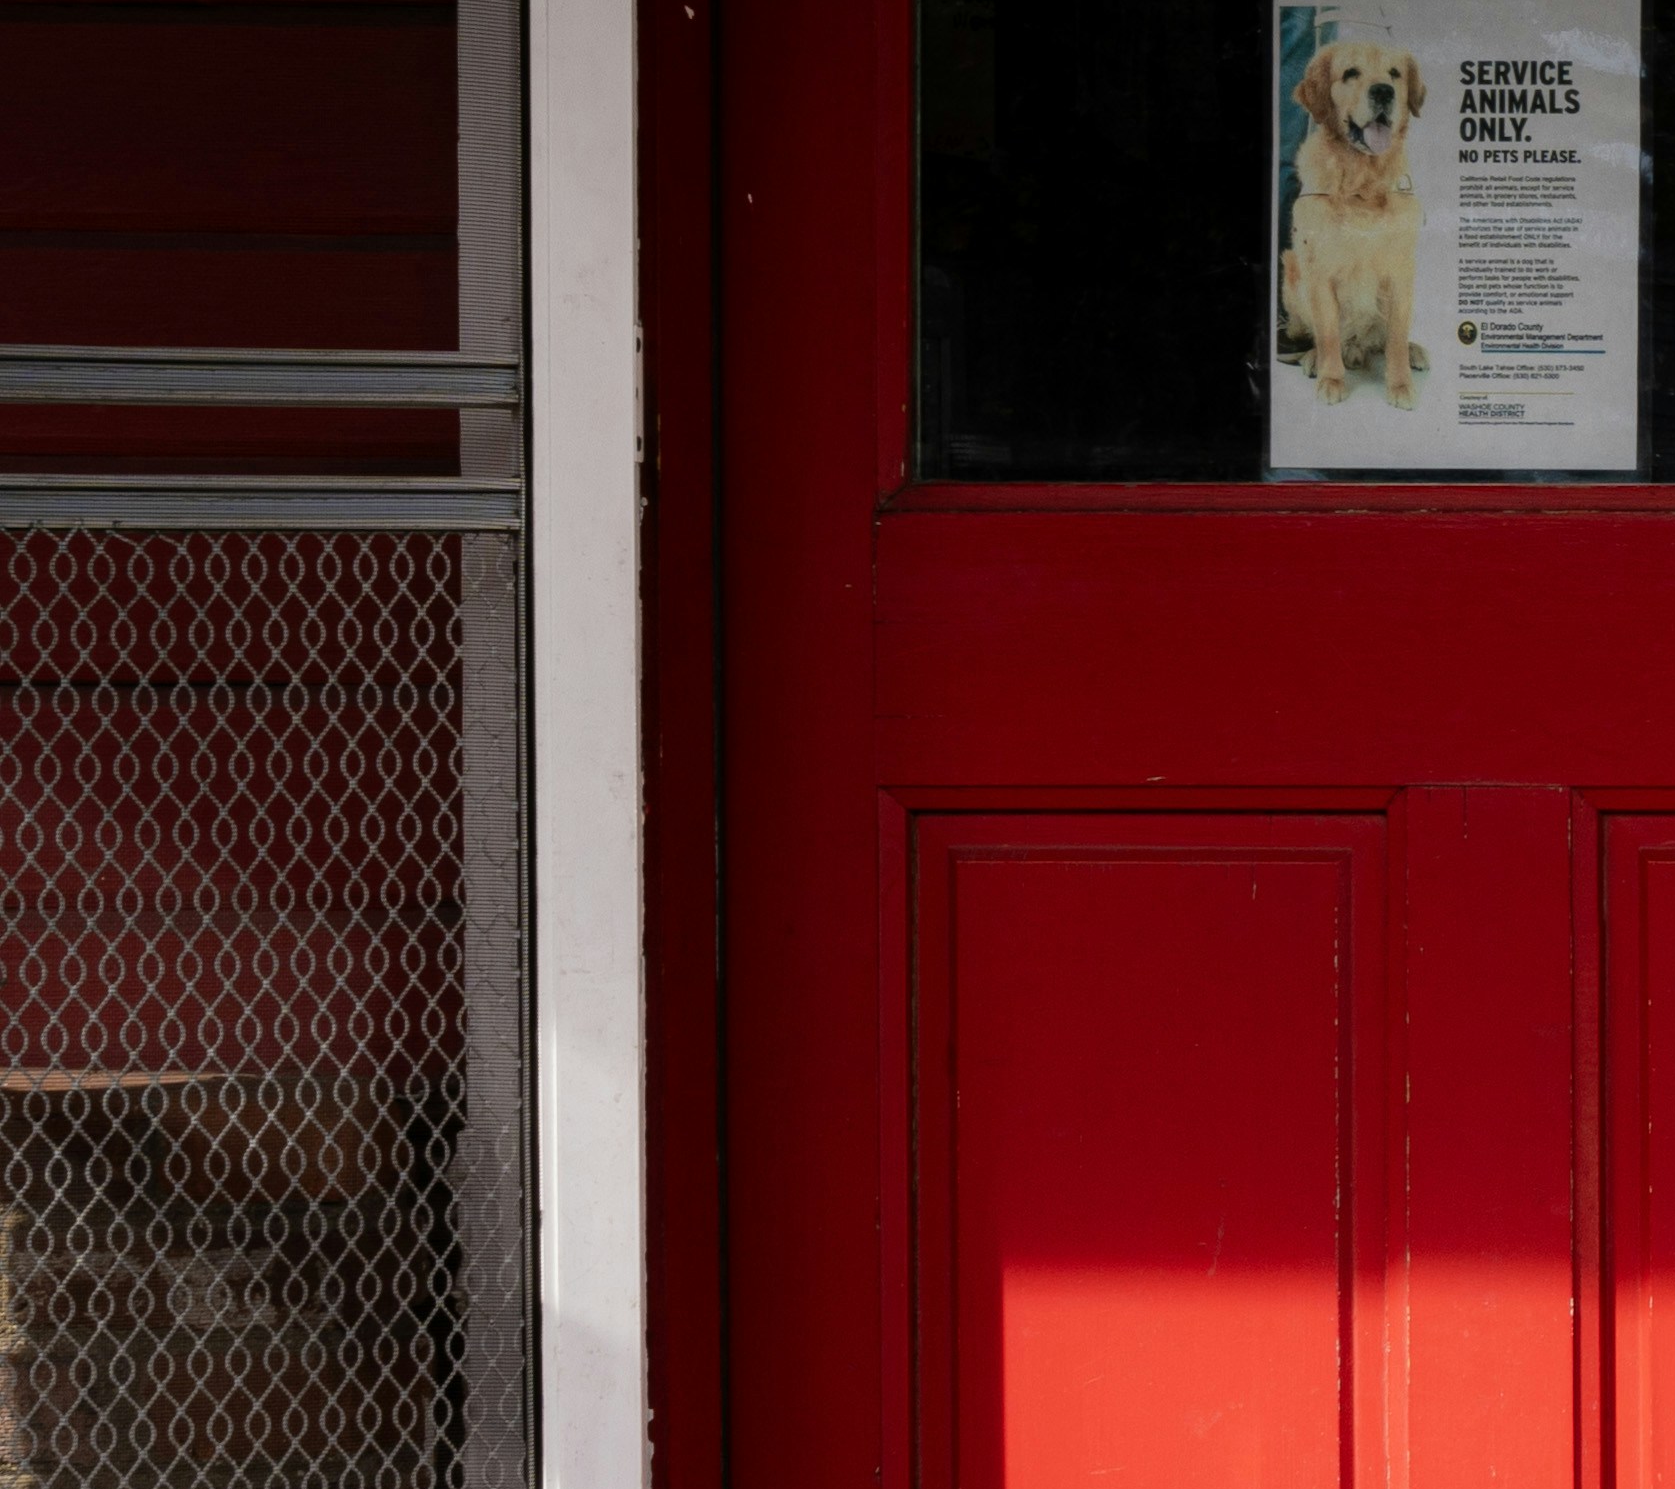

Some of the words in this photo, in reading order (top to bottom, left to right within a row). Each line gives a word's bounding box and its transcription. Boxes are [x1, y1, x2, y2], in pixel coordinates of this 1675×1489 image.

[1459, 60, 1573, 85] SERVICE
[1459, 88, 1581, 114] ANIMALS
[1459, 117, 1532, 143] ONLY.
[1459, 150, 1478, 163] NO
[1483, 150, 1519, 163] PETS
[1523, 150, 1582, 164] PLEASE.
